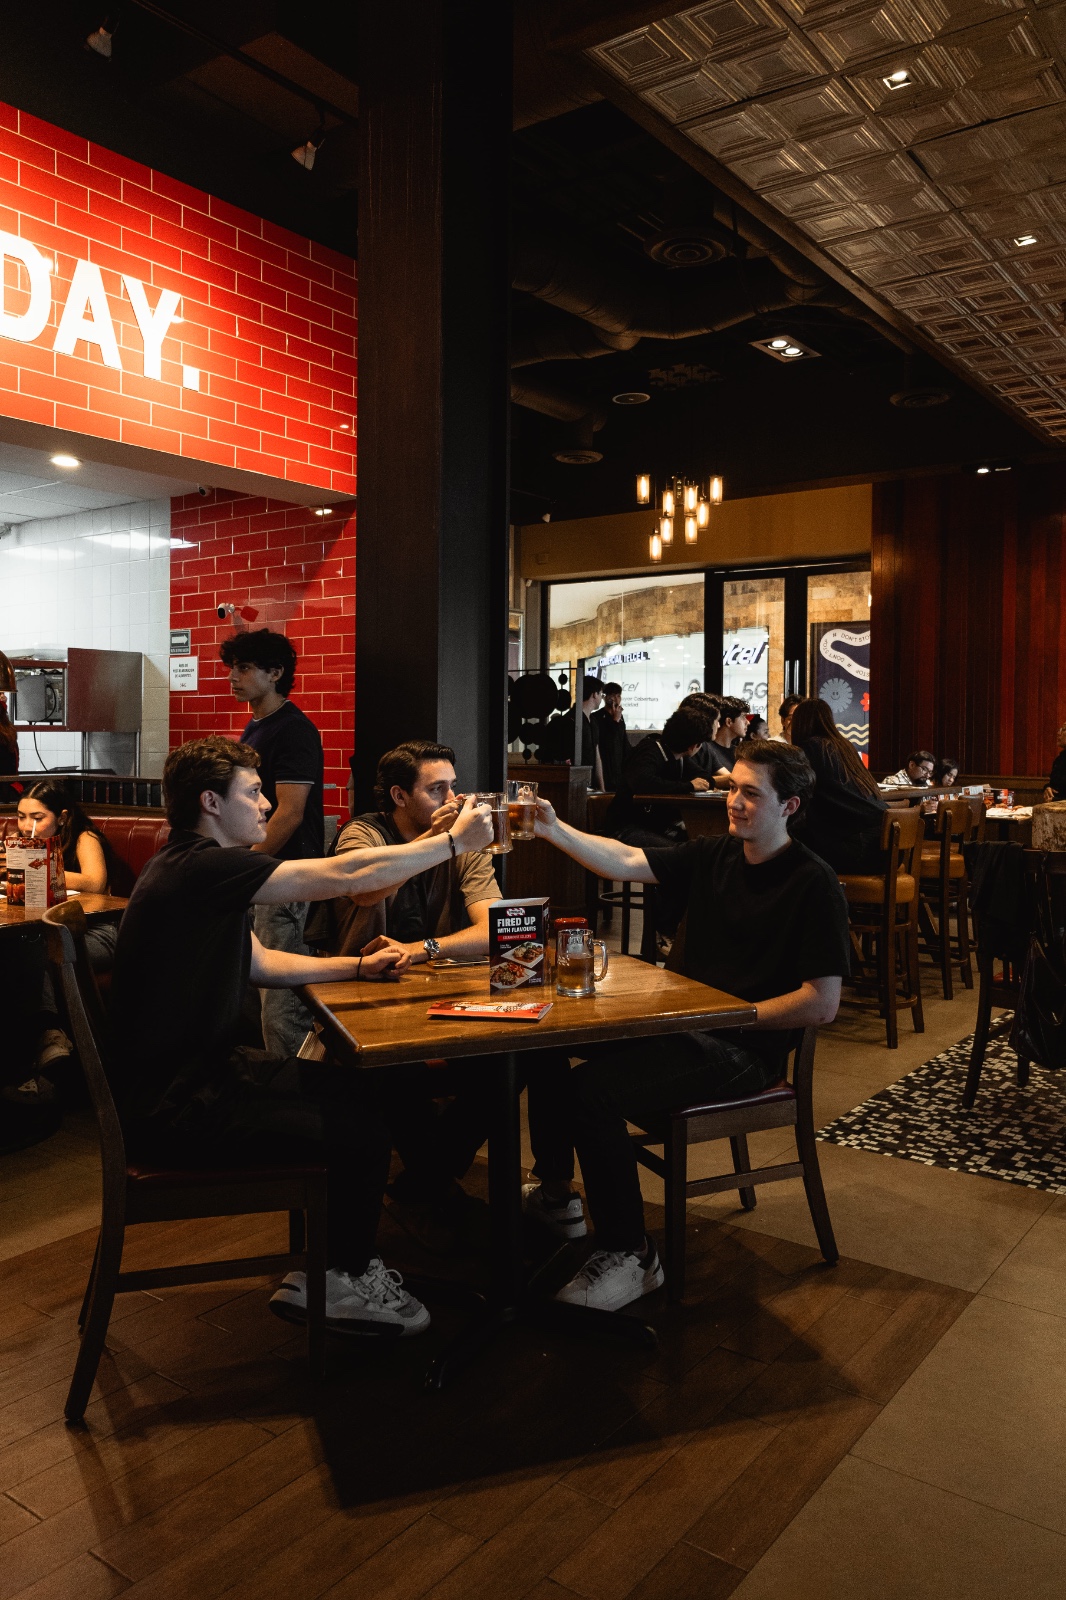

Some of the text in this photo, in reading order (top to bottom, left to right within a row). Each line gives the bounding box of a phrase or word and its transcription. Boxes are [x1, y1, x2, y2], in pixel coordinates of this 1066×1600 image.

[858, 635, 870, 643] STO
[497, 916, 536, 927] FIRED UP
